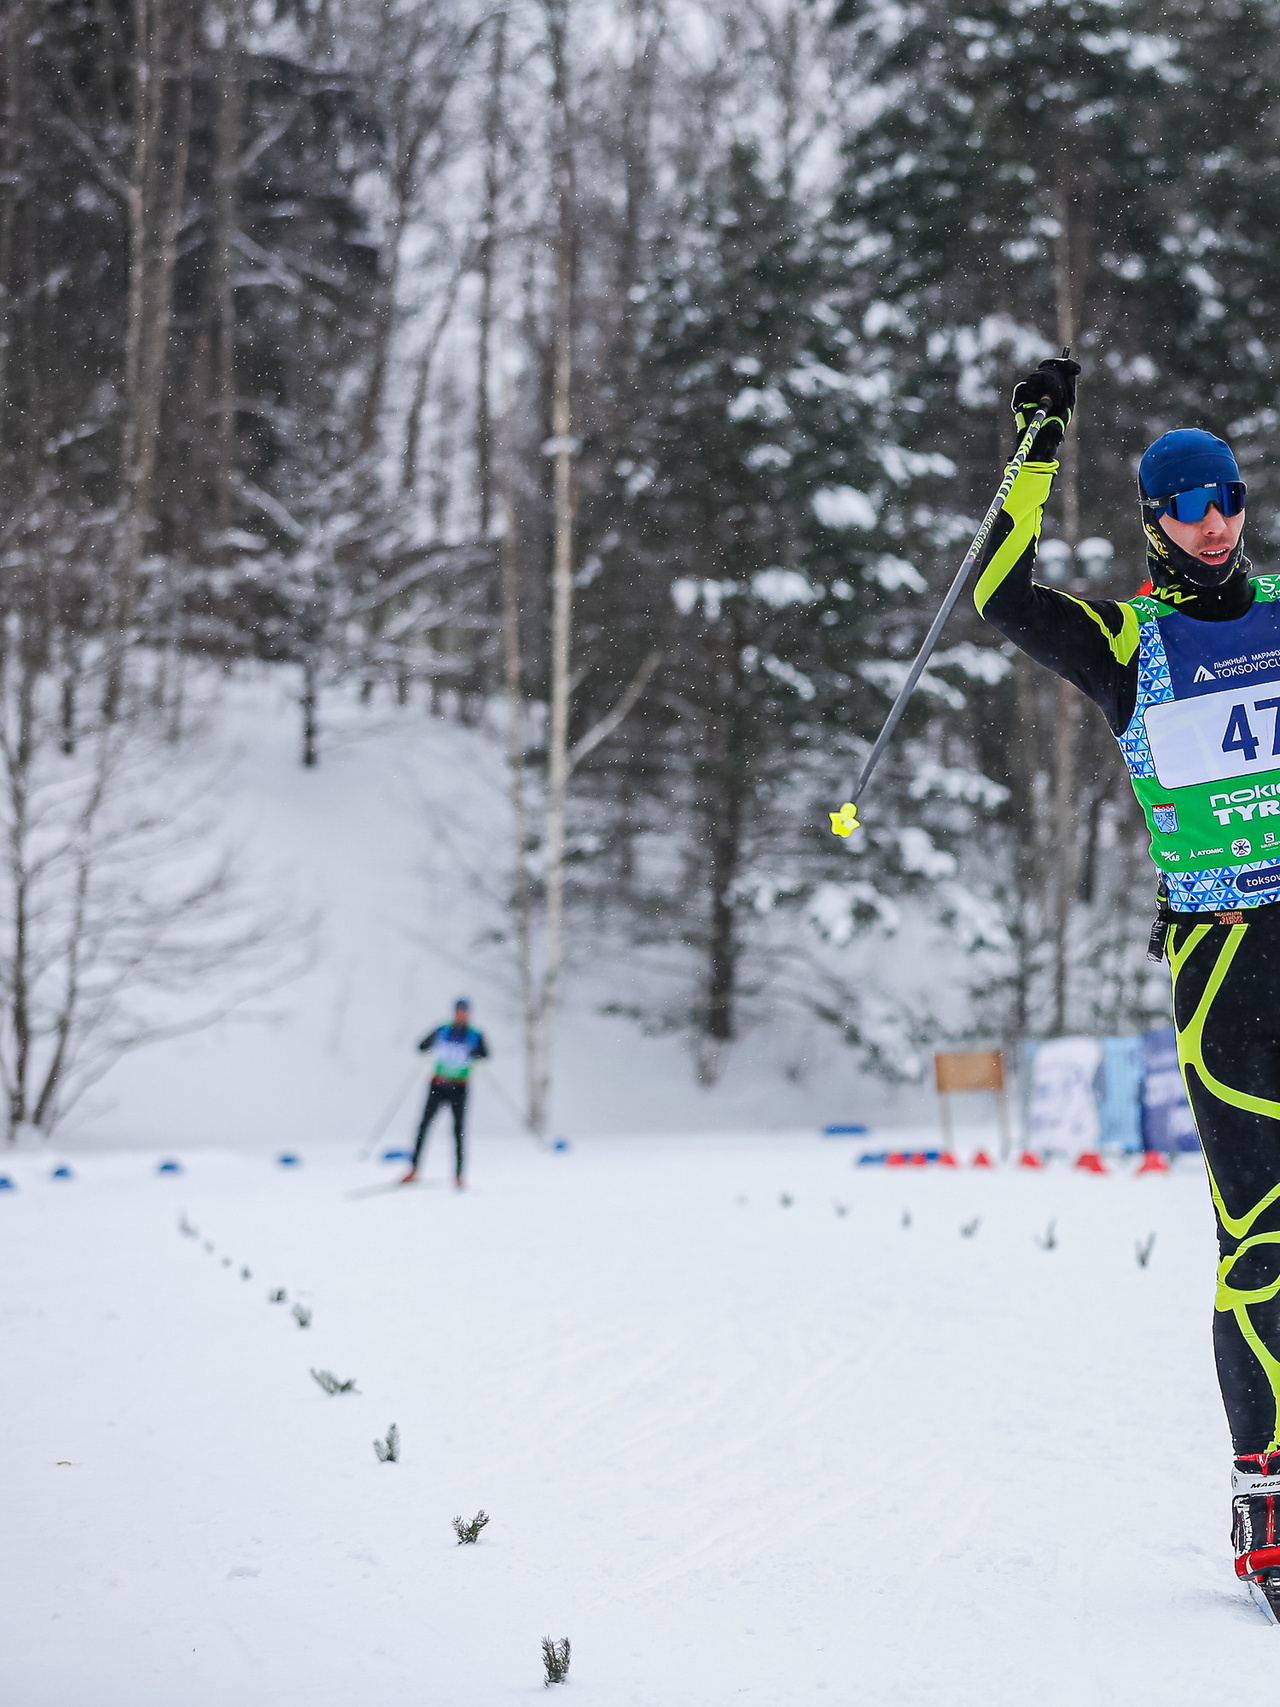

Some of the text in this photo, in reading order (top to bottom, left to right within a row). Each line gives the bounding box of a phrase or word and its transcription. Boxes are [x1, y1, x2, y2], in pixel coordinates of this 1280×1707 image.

[981, 509, 998, 534] BLACK
[1213, 655, 1248, 669] ЛЫЖНЫЙ
[1197, 848, 1224, 856] ATOMIC
